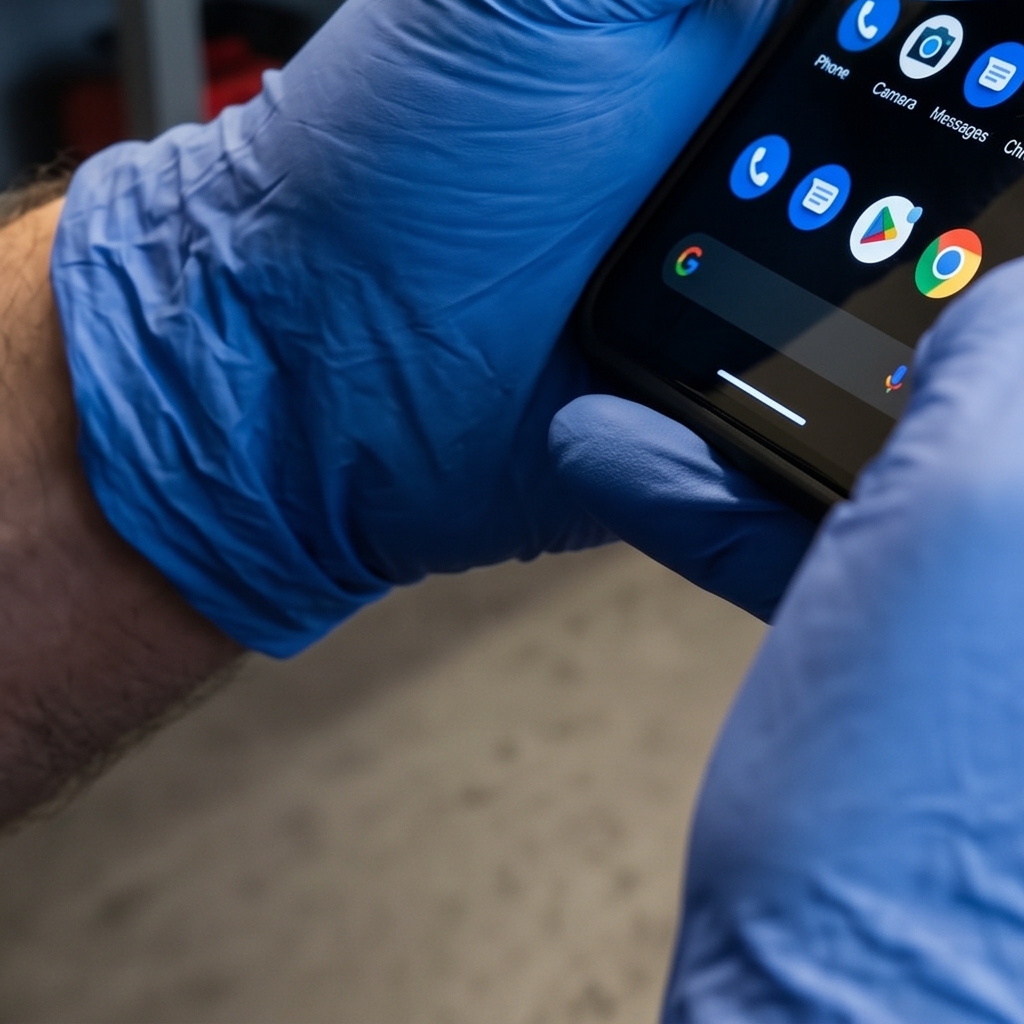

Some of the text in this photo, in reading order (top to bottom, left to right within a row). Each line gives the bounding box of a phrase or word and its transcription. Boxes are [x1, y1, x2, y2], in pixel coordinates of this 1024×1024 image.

[814, 54, 850, 80] Phone
[872, 81, 918, 110] Camera
[929, 106, 990, 143] Messages
[675, 246, 703, 276] G
